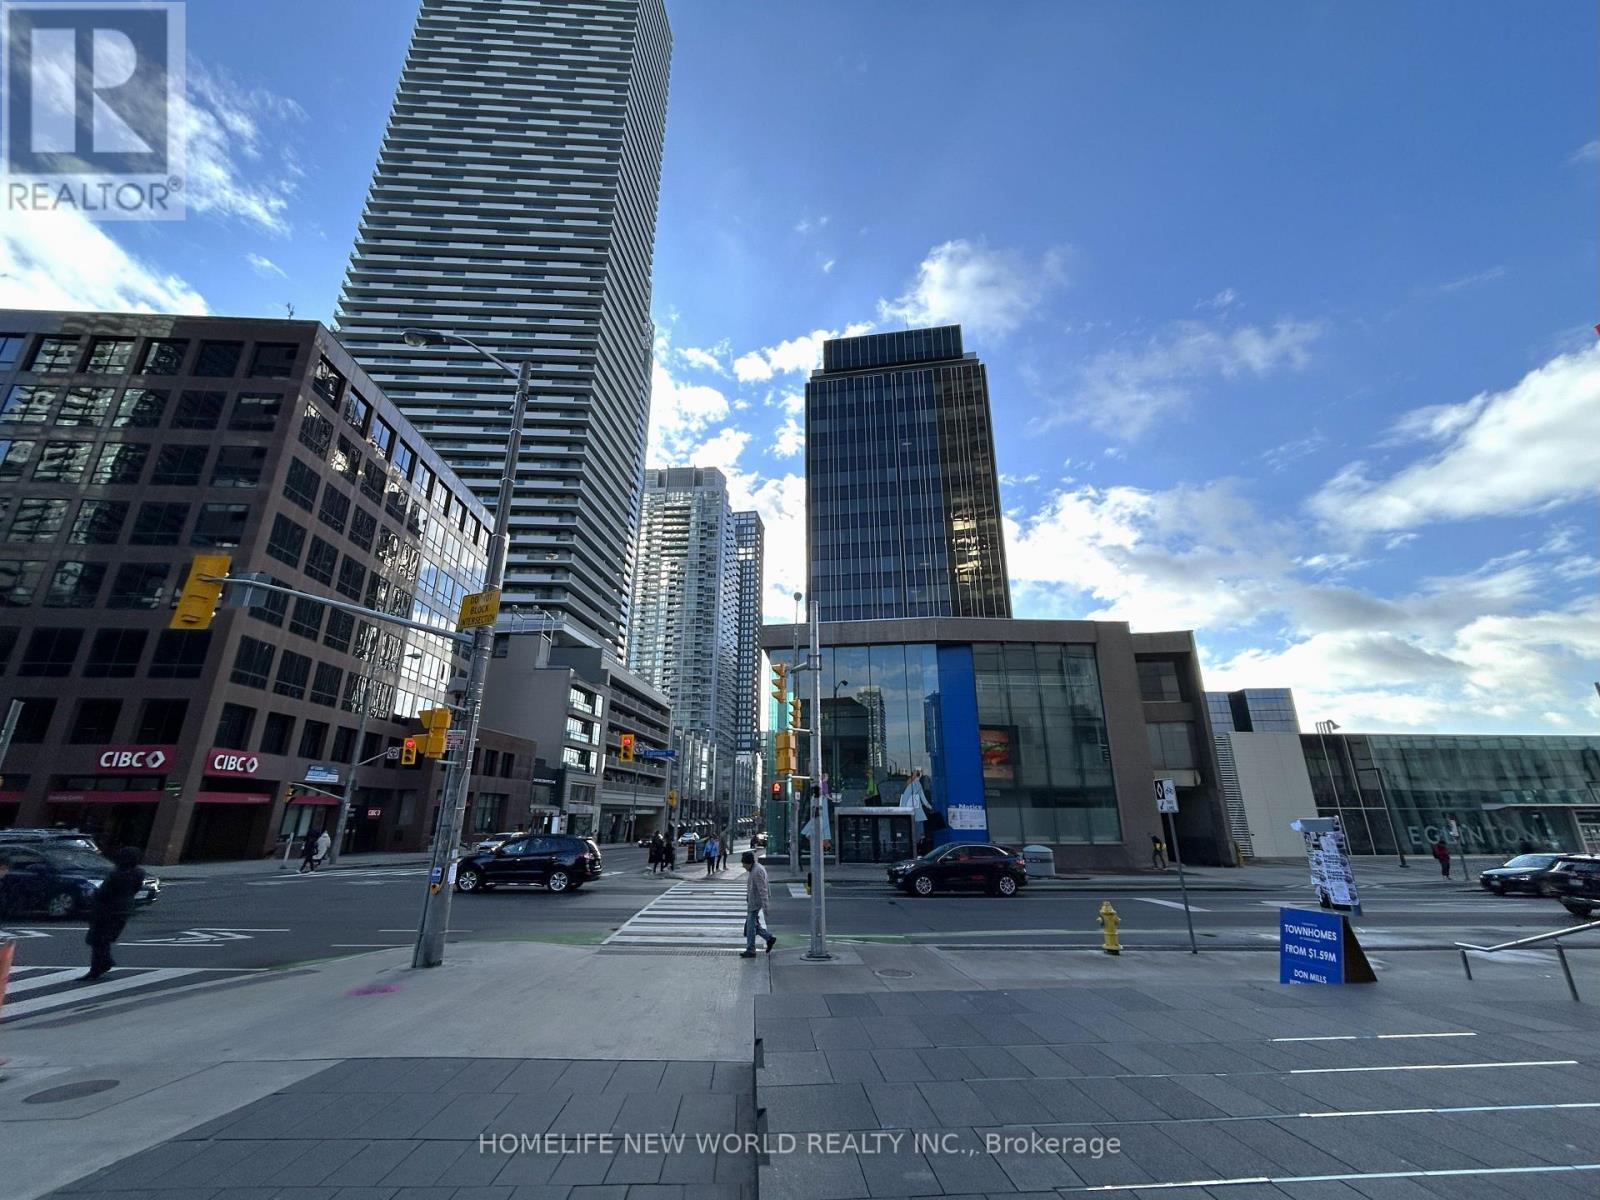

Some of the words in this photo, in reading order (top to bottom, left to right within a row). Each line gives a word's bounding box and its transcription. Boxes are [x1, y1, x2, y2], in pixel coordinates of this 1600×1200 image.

[470, 605, 488, 614] BLOCK
[462, 615, 495, 626] INTERSECTION
[99, 751, 147, 768] CIBC
[213, 754, 246, 771] CIBC
[958, 803, 983, 811] Notice
[1407, 824, 1540, 846] EGLINTON
[1284, 924, 1337, 941] TOWNHOMES
[1285, 944, 1307, 956] FROM
[1308, 947, 1337, 963] $1.59M
[1294, 969, 1309, 979] DON
[1309, 973, 1327, 984] MILLS
